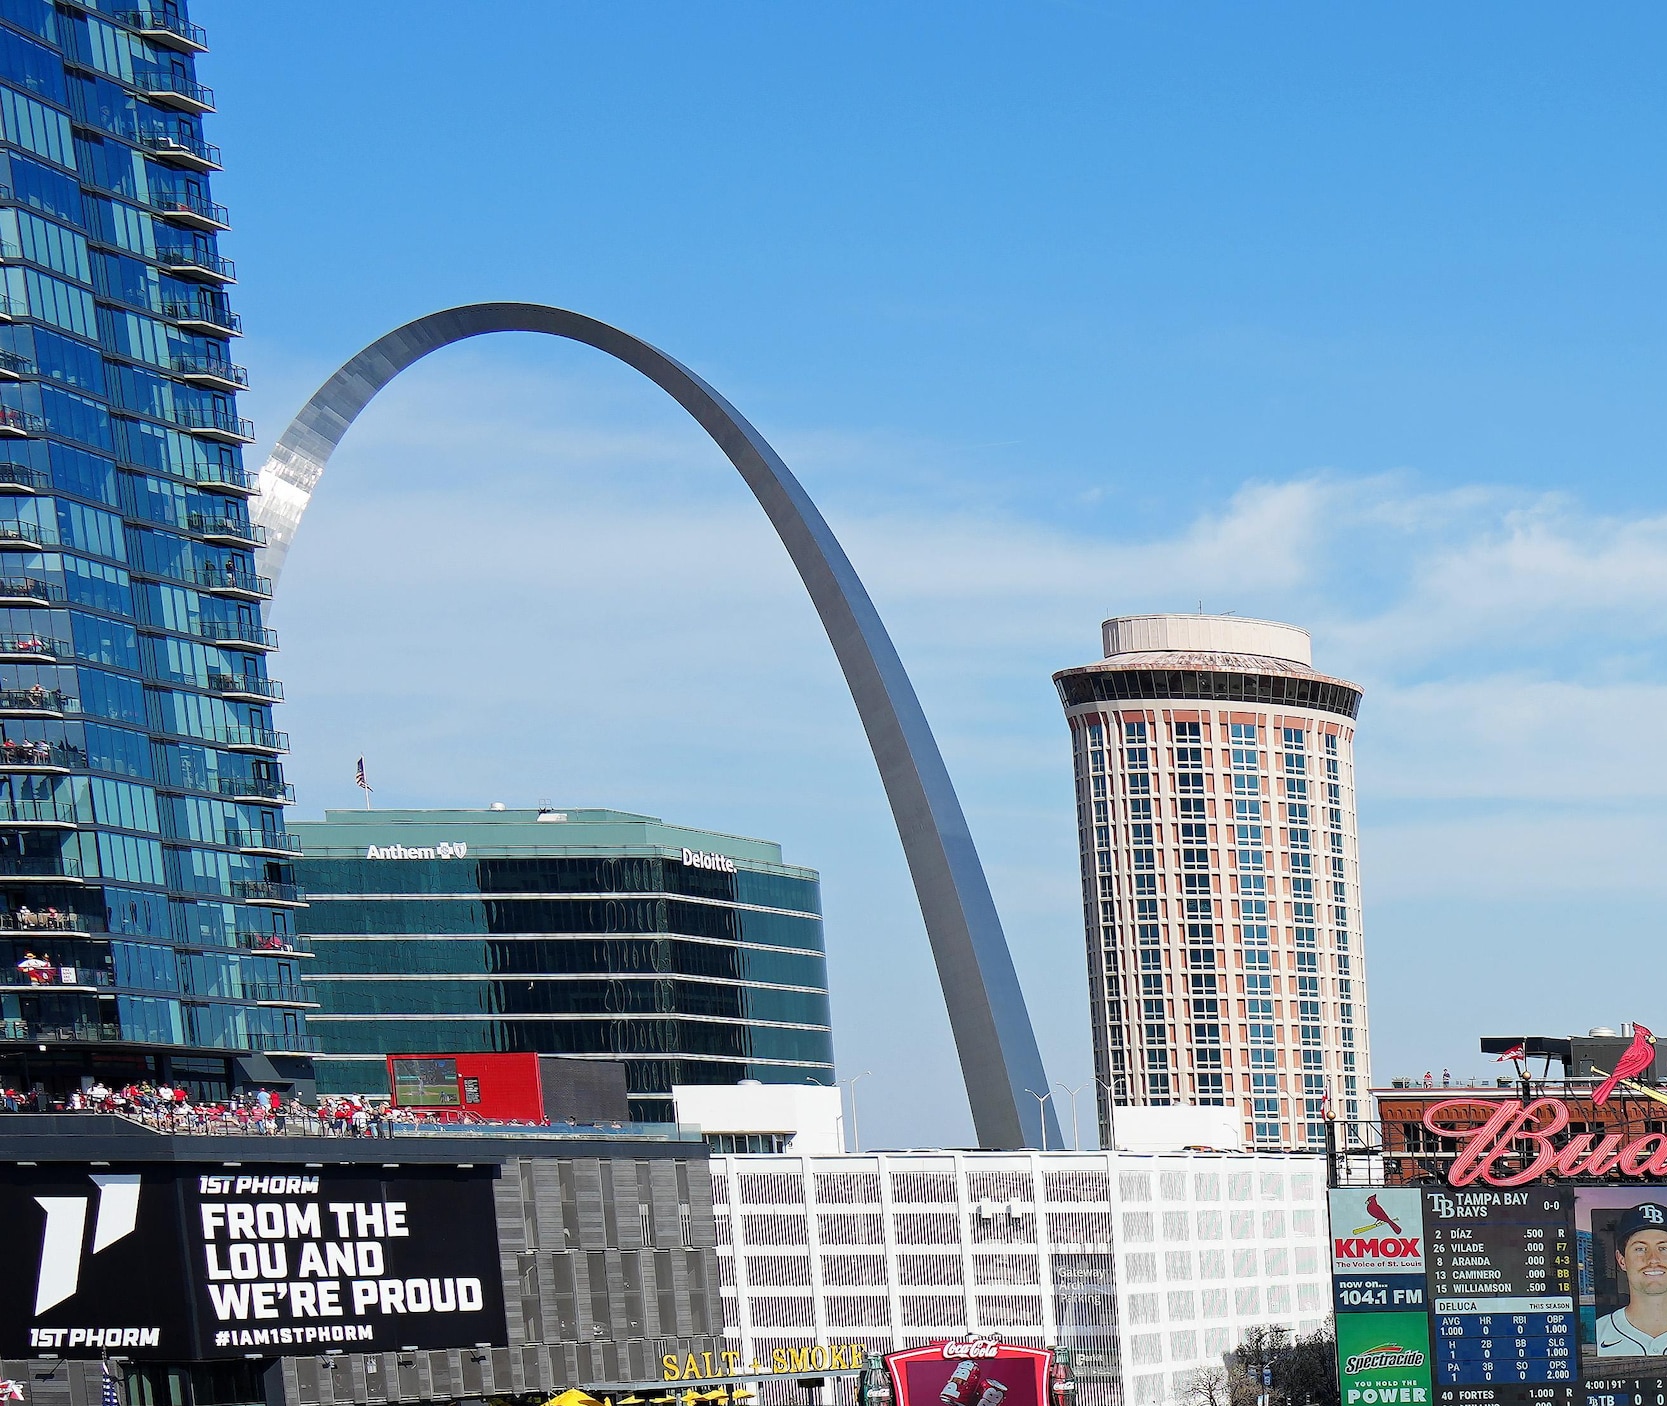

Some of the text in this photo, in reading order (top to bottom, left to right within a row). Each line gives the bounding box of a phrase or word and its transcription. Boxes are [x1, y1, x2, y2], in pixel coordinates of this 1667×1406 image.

[366, 844, 434, 860] Anthem
[682, 848, 738, 873] Deloitte.
[200, 1175, 319, 1194] 1ST PHORM
[1456, 1193, 1528, 1205] TAMPA BAY
[1456, 1206, 1488, 1217] RAYS
[201, 1202, 409, 1239] FROM THE
[1451, 1228, 1472, 1239] DÍAZ
[1335, 1238, 1421, 1259] KMOX
[1451, 1244, 1484, 1252] VILADE
[204, 1242, 384, 1280] LOU AND
[1452, 1257, 1490, 1266] ARANDA
[1453, 1270, 1500, 1279] CAMINERO
[1453, 1284, 1512, 1292] WILLIAMSON
[207, 1278, 483, 1320] WE'RE PROUD
[1340, 1289, 1422, 1305] 104.1 FM
[1440, 1302, 1477, 1310] DELUCA
[30, 1328, 160, 1347] 1ST PHORM
[215, 1325, 373, 1347] #IAM1STPHORM
[943, 1340, 1000, 1359] Coca-Cola
[662, 1344, 865, 1381] SALT SMOKE
[1345, 1351, 1424, 1374] Spectracide
[1348, 1388, 1427, 1404] POWER
[1460, 1390, 1494, 1399] FORTES
